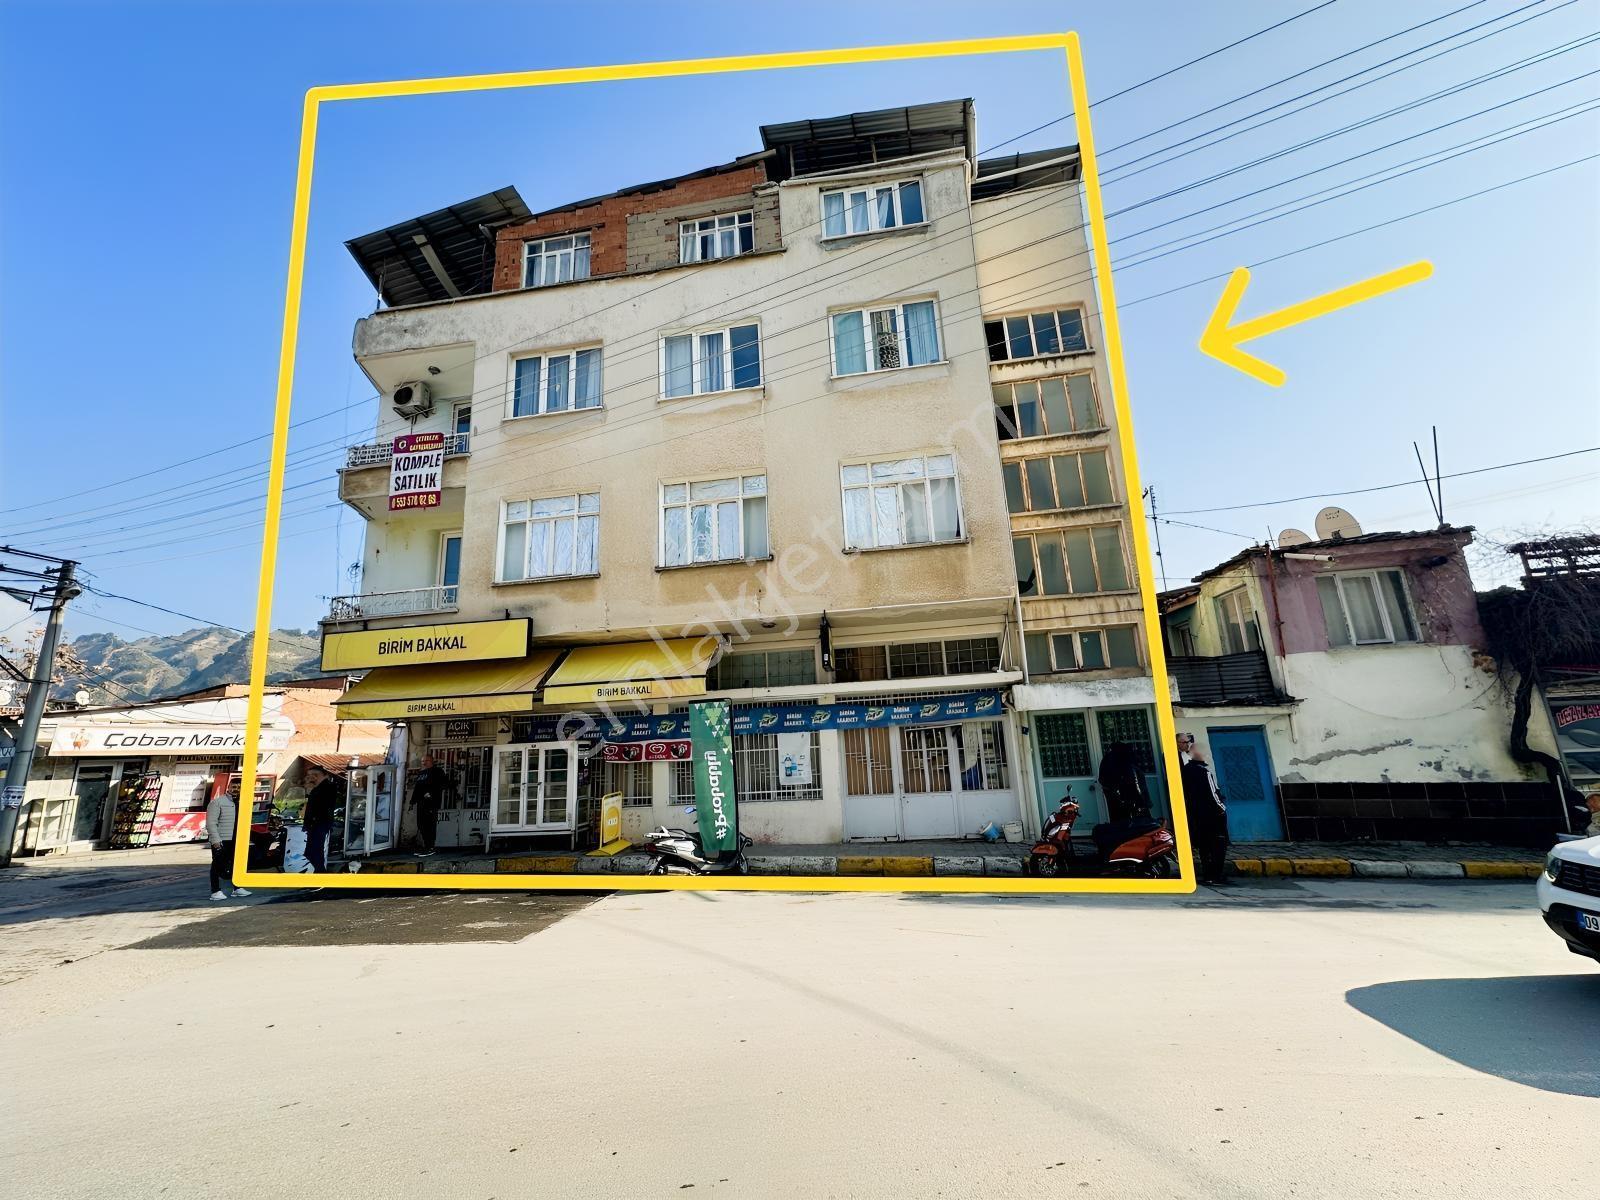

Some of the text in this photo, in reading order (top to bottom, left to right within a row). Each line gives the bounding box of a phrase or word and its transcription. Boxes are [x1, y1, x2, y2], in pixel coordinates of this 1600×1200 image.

[394, 453, 442, 472] KOMPLE
[394, 472, 437, 491] SATILIK
[378, 635, 467, 655] BİRİM BAKKAL
[620, 685, 651, 696] BAKKAL
[427, 702, 456, 712] BAKKAL
[103, 733, 186, 749] Çoban
